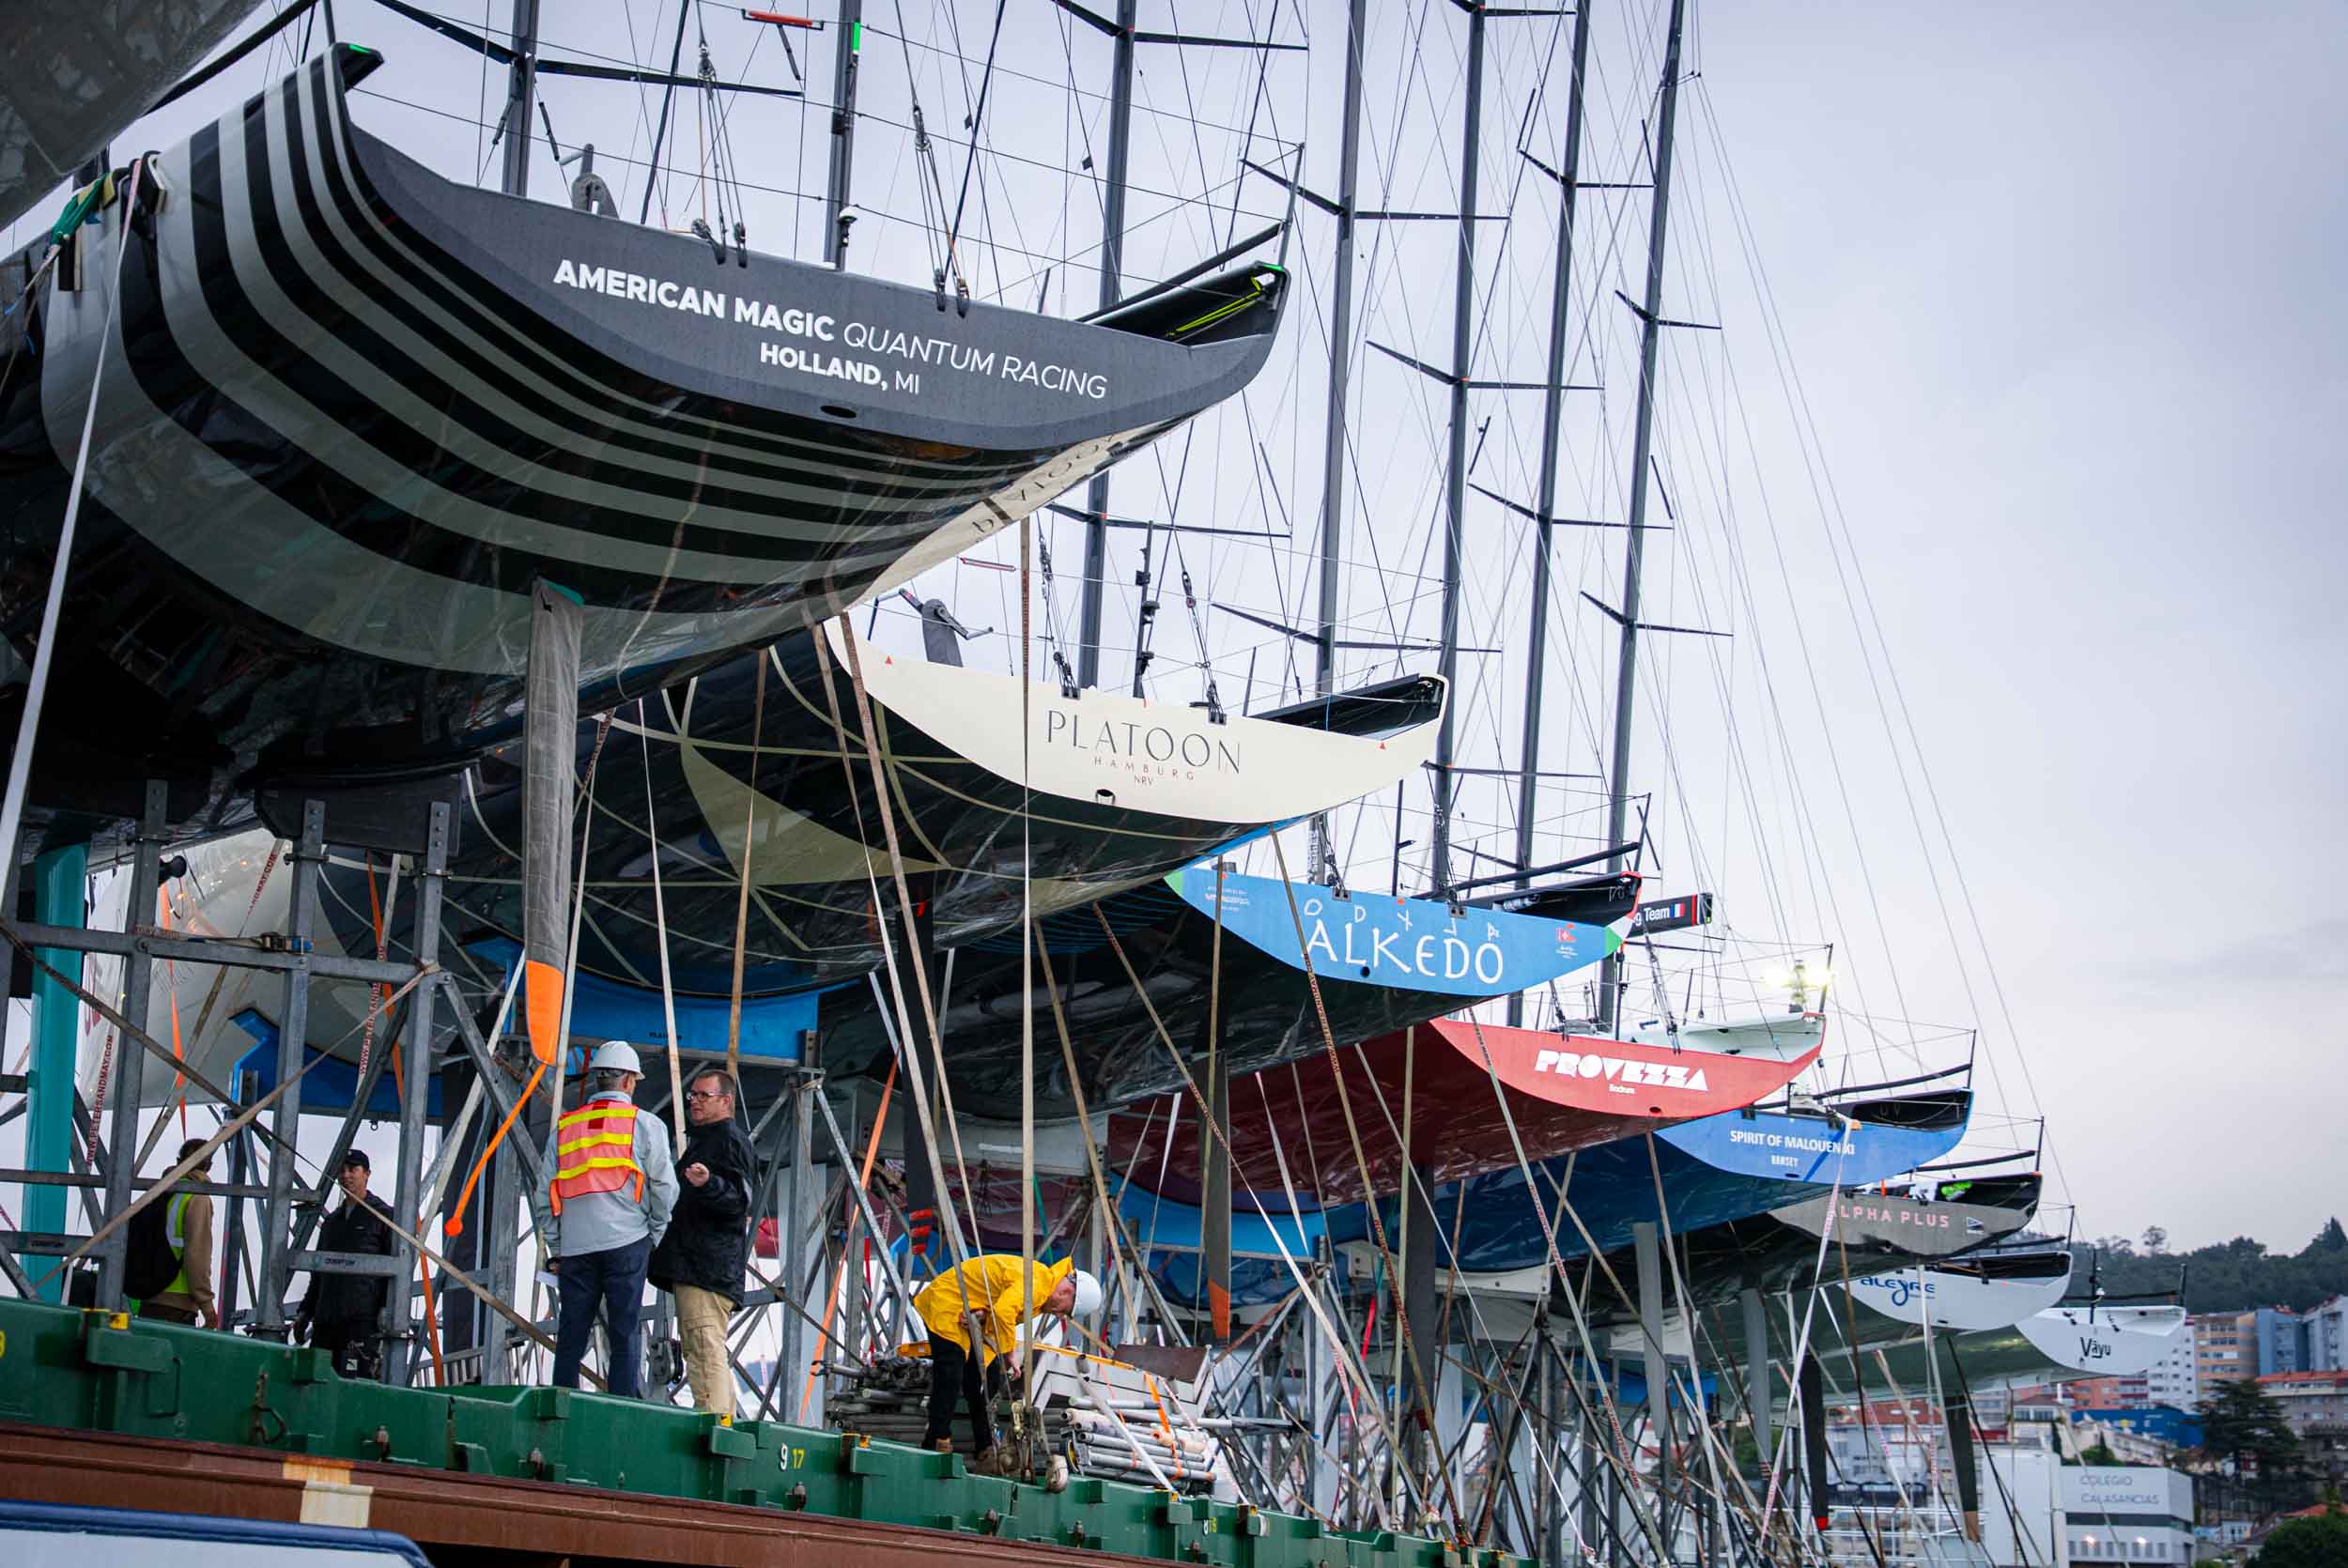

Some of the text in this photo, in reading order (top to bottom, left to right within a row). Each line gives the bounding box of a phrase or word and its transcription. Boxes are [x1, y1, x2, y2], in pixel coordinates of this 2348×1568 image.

[553, 259, 1108, 399] AMERICAN MAGIC QUANTUM RACING
[760, 342, 920, 394] HOLLAND, MI
[1046, 710, 1241, 774] PLATOON
[1094, 756, 1195, 781] HAMBURG
[1644, 907, 1670, 922] Team
[1301, 918, 1503, 985] ALKEDO
[1534, 1049, 1708, 1091] PROVEZZA
[85, 1034, 114, 1168] WWW.PETERSANDMAY.COM
[1608, 1084, 1635, 1095] Bodrum
[1730, 1130, 1767, 1145] SPIRIT
[1767, 1134, 1783, 1147] OF
[1784, 1136, 1842, 1155] MALOUEN
[1900, 1211, 1950, 1228] PLUS
[780, 1442, 805, 1470] 9 17
[2081, 1475, 2134, 1487] COLEGIO
